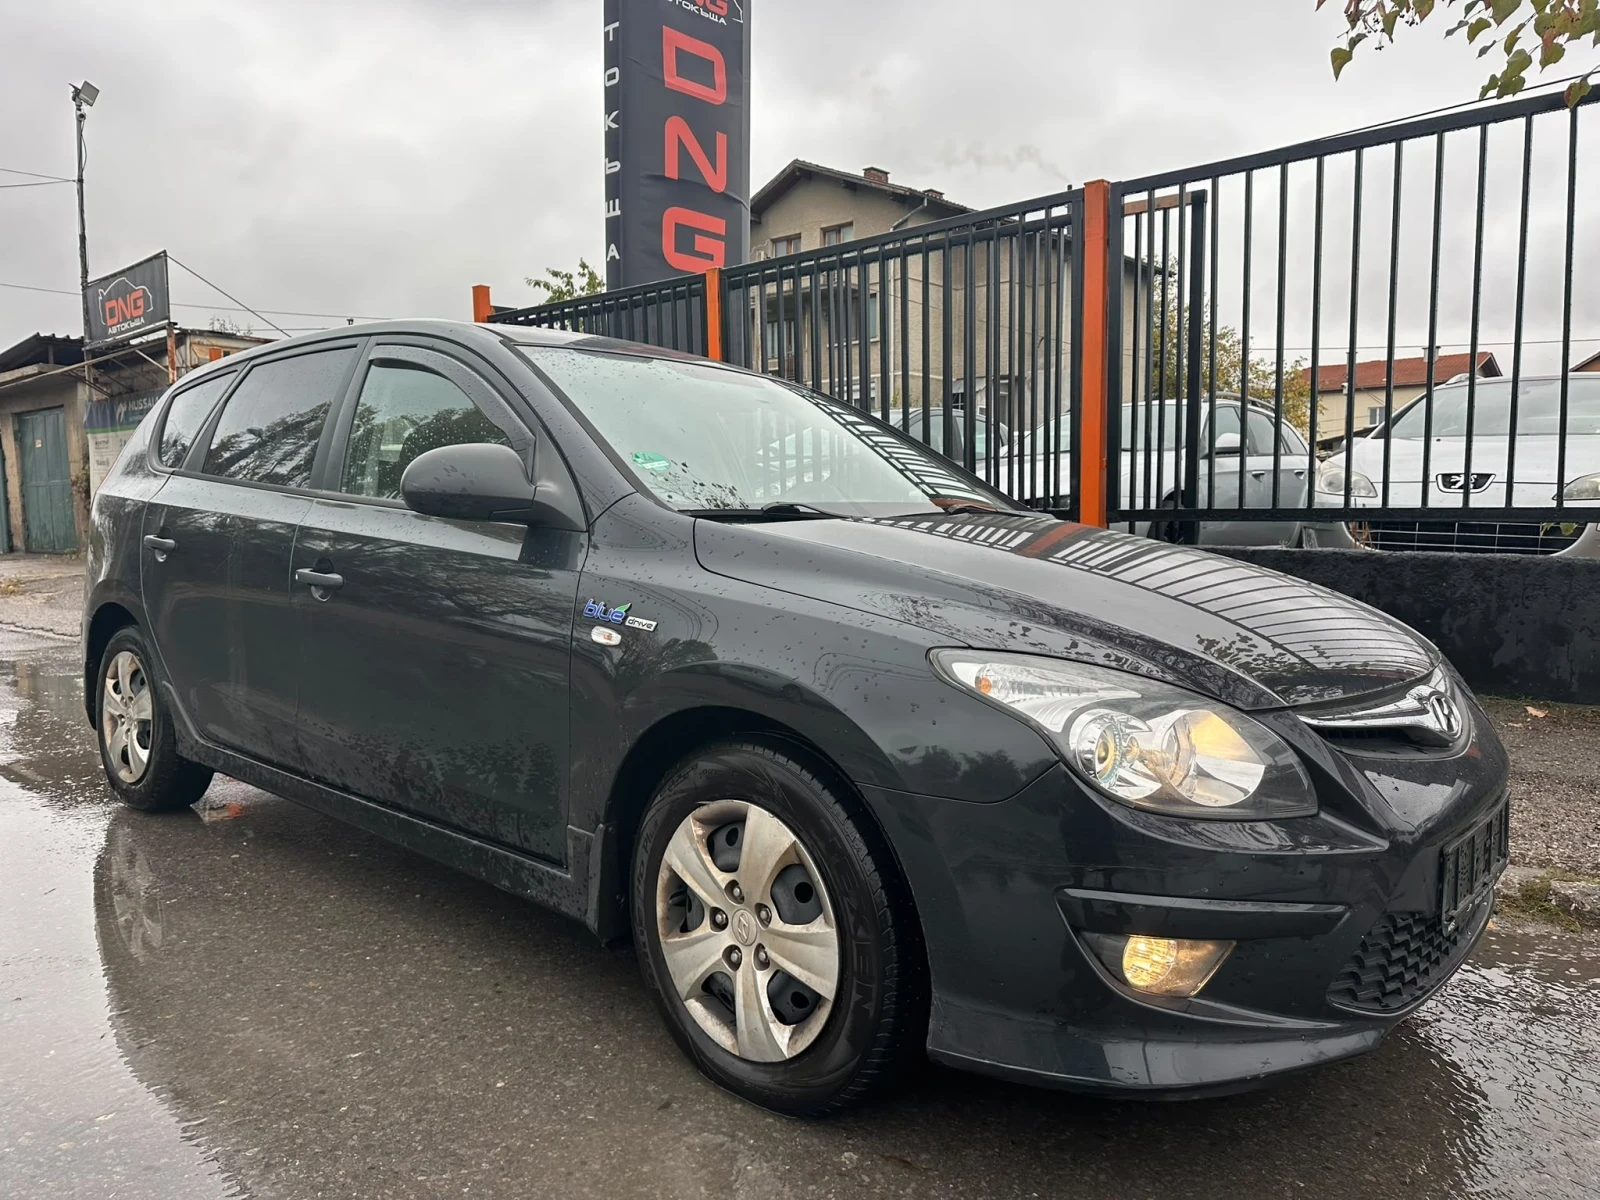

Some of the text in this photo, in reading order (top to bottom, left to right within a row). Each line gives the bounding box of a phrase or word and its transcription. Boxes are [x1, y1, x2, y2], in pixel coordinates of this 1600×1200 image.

[662, 25, 728, 274] DNG
[105, 289, 144, 326] DNG
[583, 598, 626, 624] blue
[627, 618, 653, 629] drive
